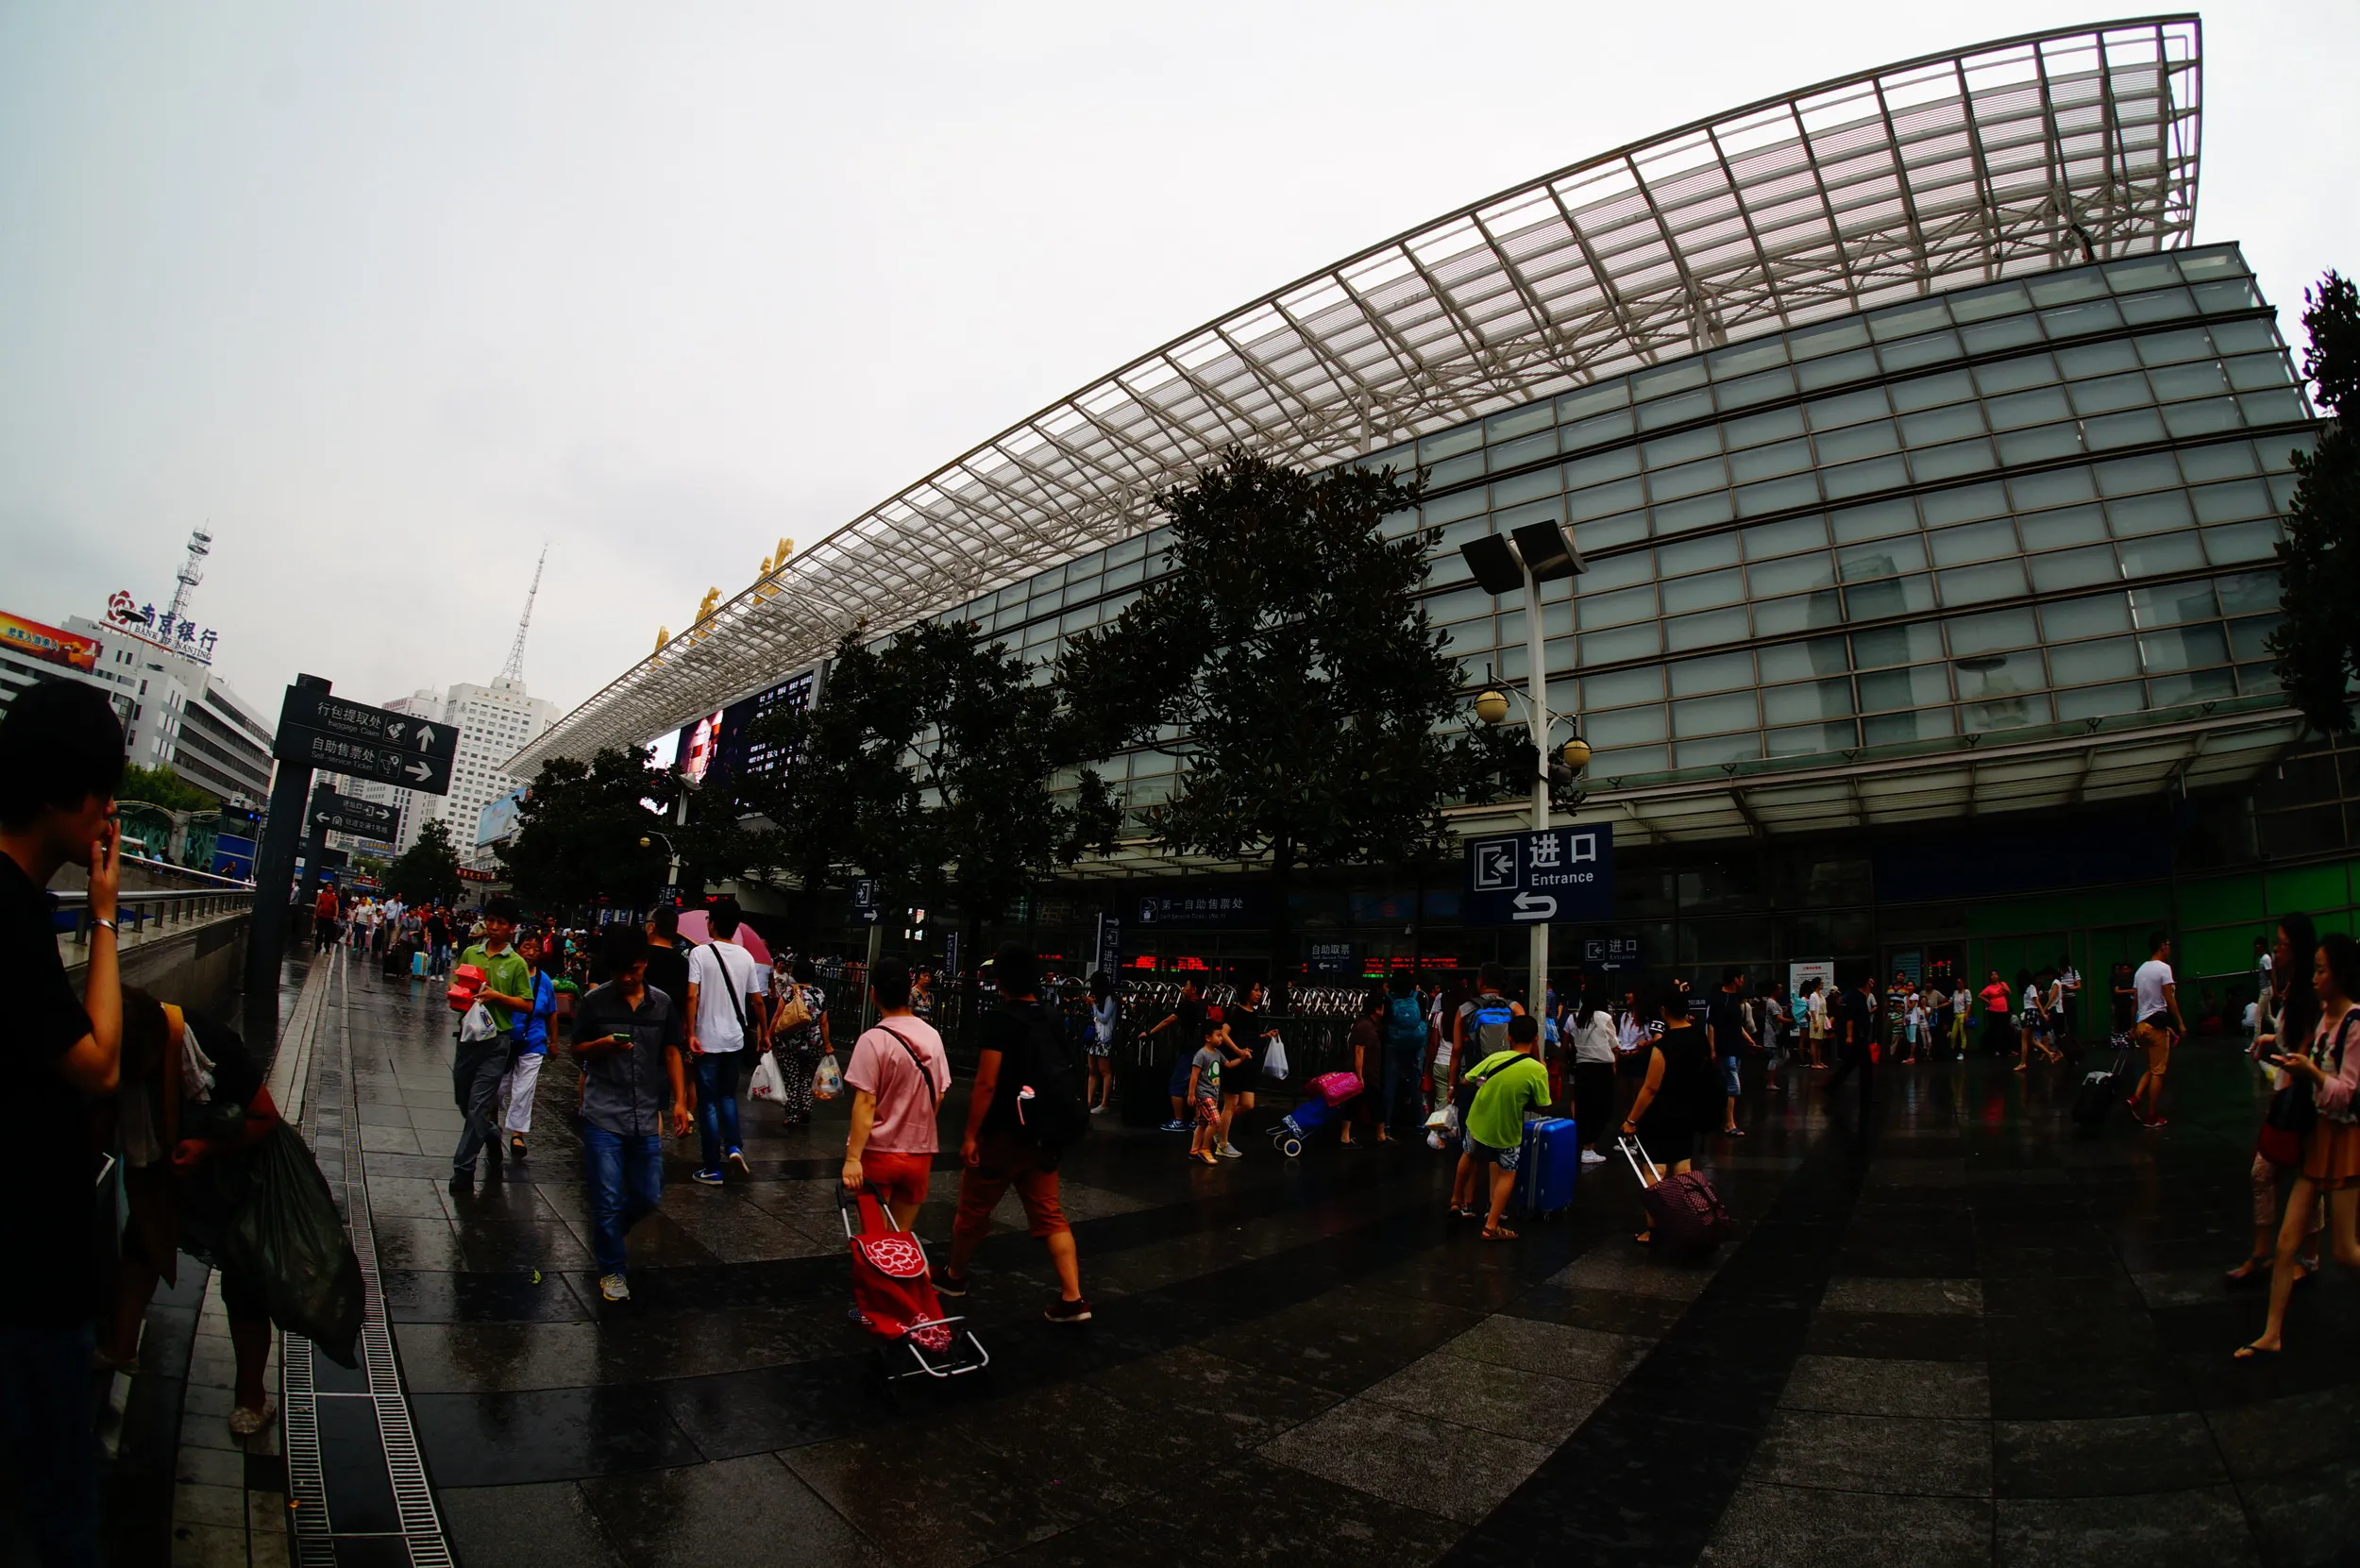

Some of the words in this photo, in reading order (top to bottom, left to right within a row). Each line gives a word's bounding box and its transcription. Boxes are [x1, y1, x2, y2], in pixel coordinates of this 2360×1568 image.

[140, 603, 218, 651] 南京银行
[134, 625, 158, 640] BANK
[176, 639, 212, 661] NANJING
[317, 702, 381, 730] 行包提取处
[328, 718, 358, 733] Baggage
[361, 727, 379, 736] Claim
[312, 736, 375, 764] 自助售票处
[353, 760, 374, 771] Ticket
[1529, 833, 1597, 868] 进口
[1531, 872, 1593, 886] Entrance
[1162, 897, 1243, 911] 第一自助售票处
[1311, 943, 1351, 955] 自助取票
[1609, 938, 1637, 953] 进口
